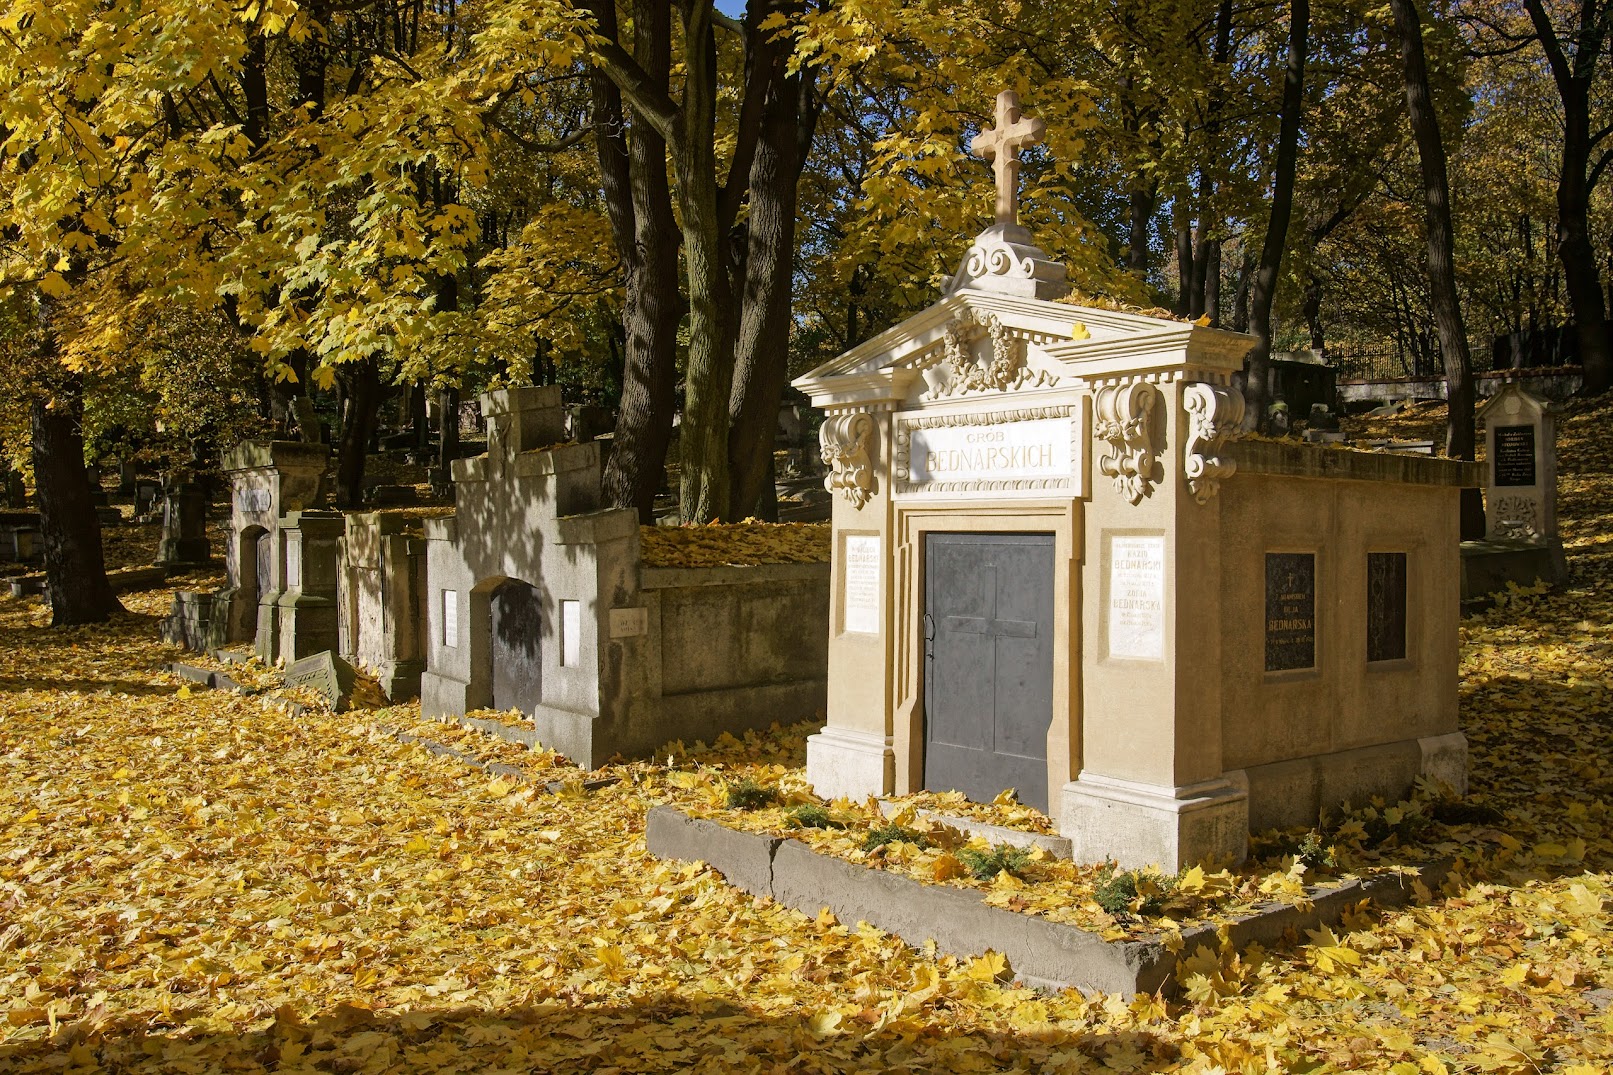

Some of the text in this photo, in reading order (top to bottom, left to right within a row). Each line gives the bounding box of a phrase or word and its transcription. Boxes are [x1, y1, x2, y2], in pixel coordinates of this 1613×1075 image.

[967, 428, 1005, 443] GRÓB
[1114, 559, 1161, 571] BEDNARSKI
[1113, 598, 1161, 611] BEDNARSKA
[1268, 619, 1312, 632] BEDNARSKA
